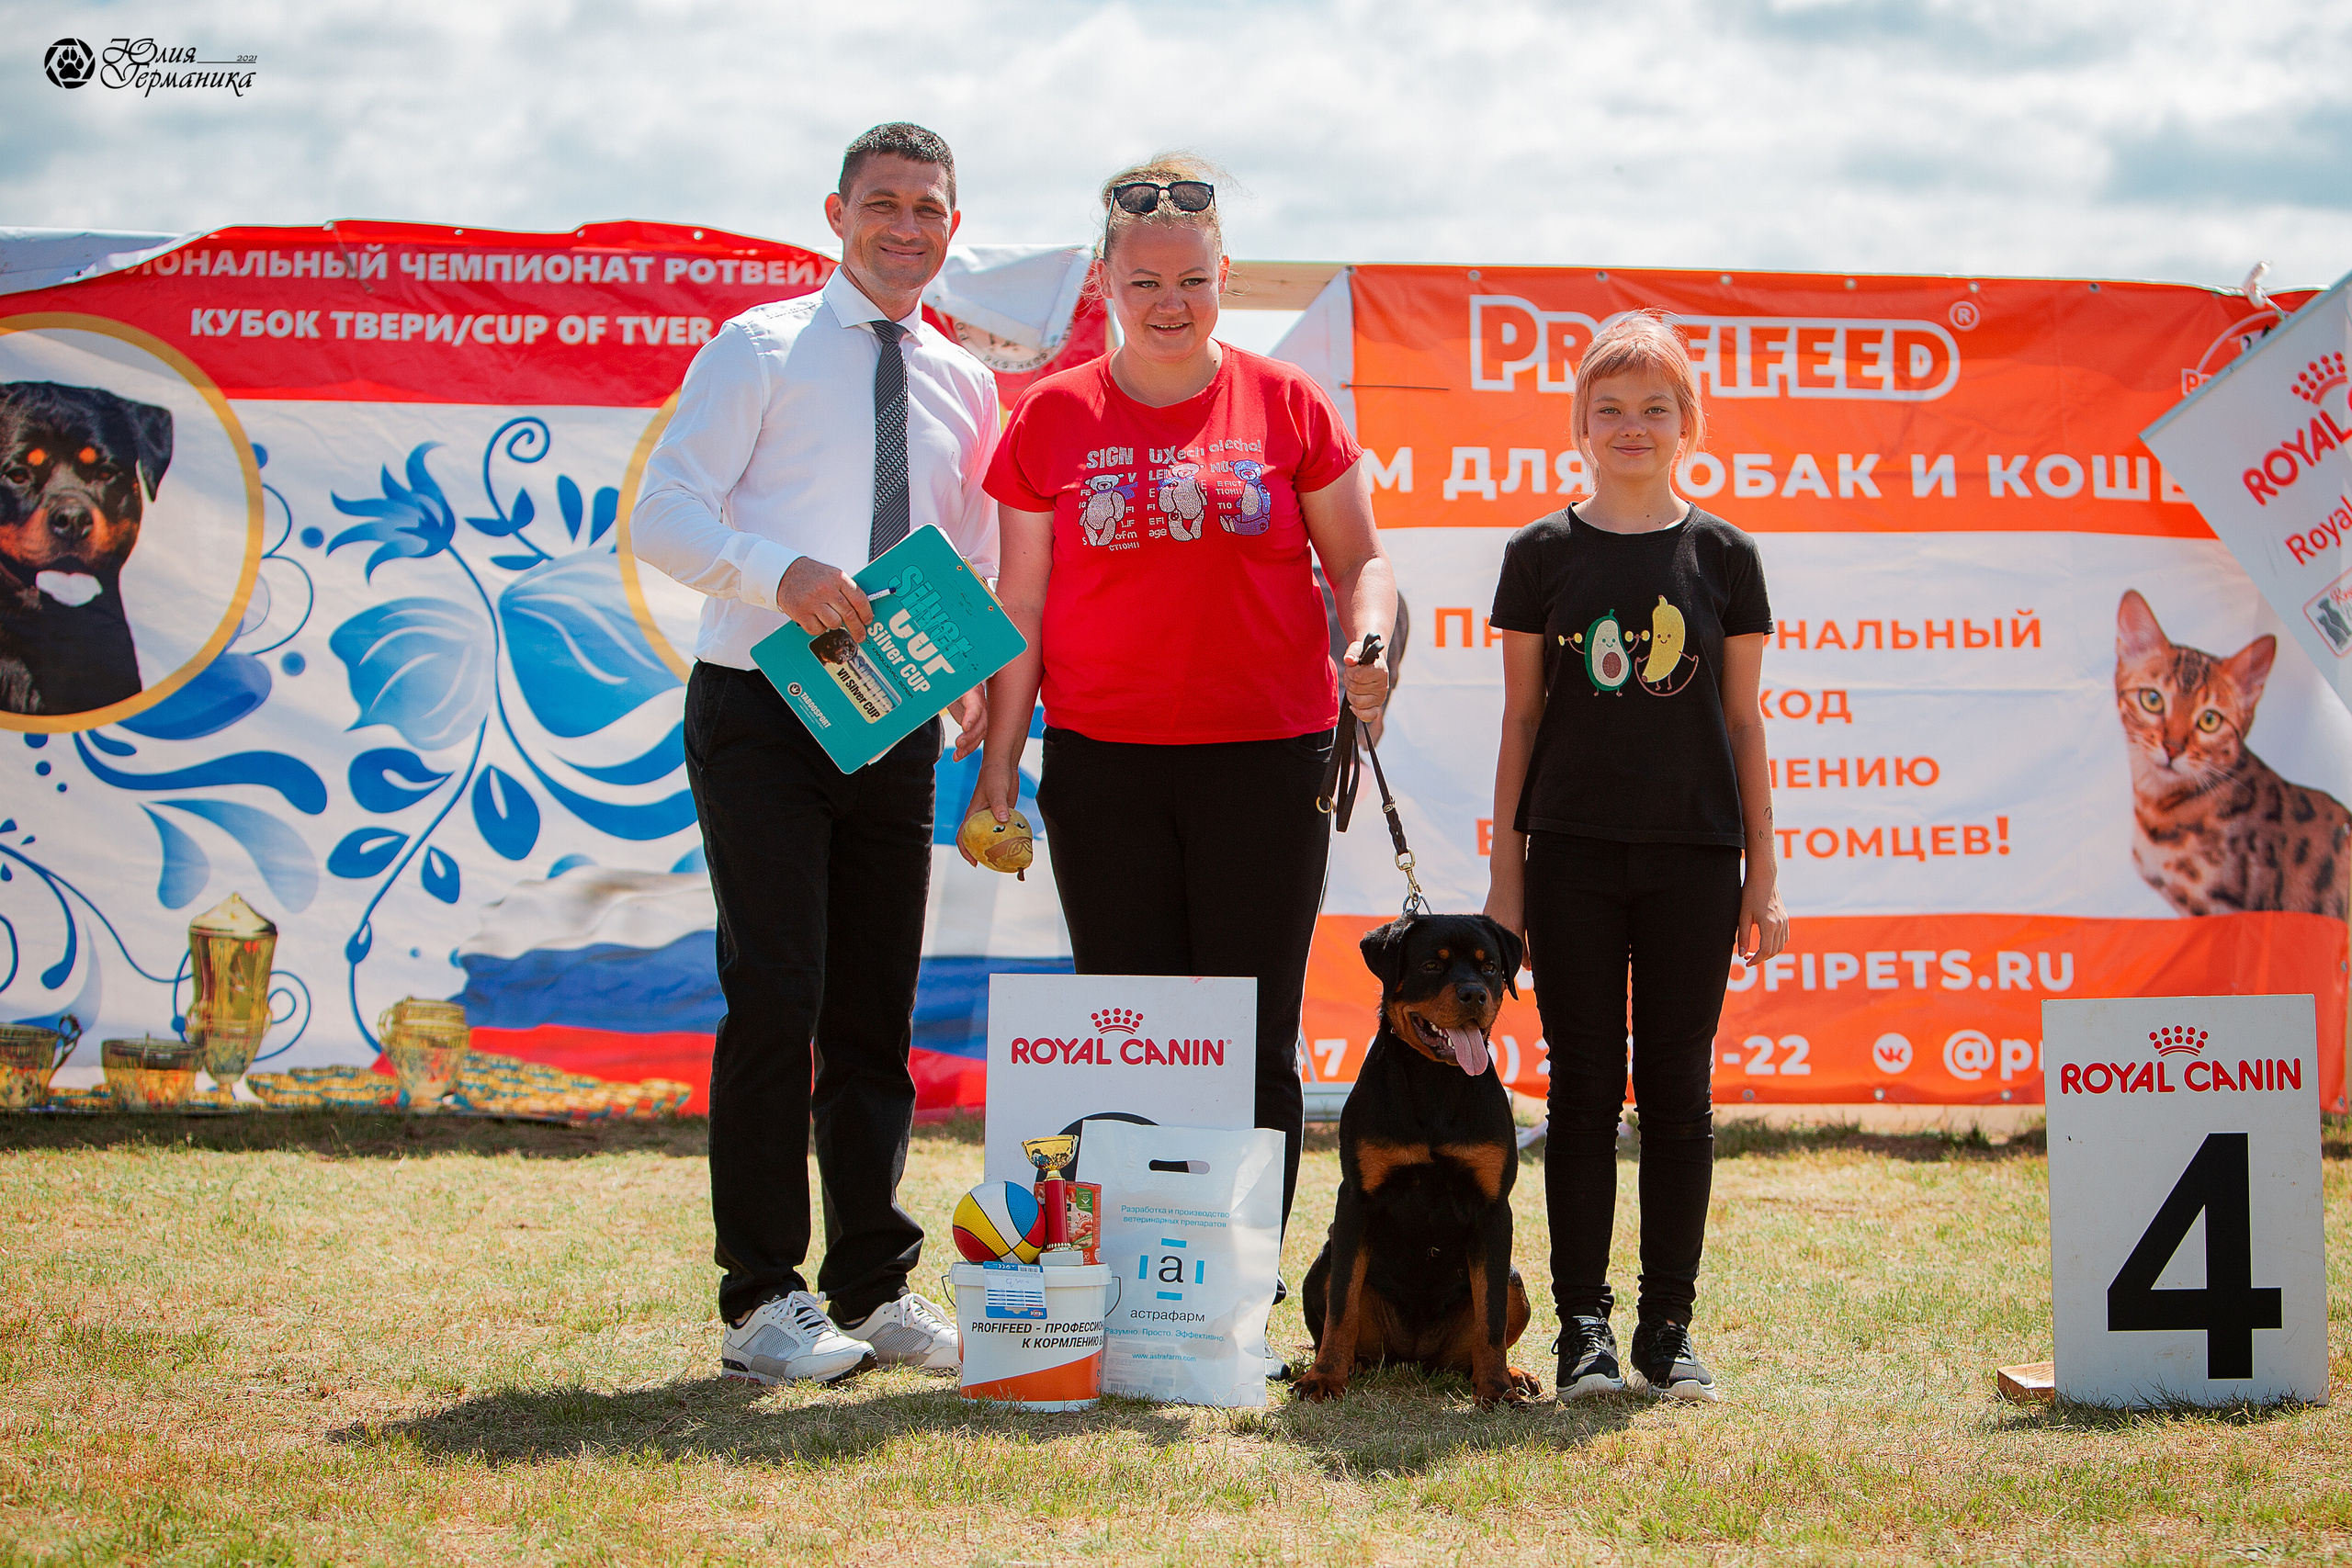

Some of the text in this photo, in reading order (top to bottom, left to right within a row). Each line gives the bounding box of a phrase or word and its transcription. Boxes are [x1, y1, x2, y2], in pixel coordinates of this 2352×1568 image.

[399, 252, 653, 284] ЧЕМПИОНАТ
[190, 308, 321, 339] КУБОК
[556, 315, 606, 344] OF
[616, 316, 713, 346] TVER
[1086, 446, 1134, 469] SIGN
[1443, 446, 1599, 501] ДЛЯ
[1675, 452, 1883, 499] ОБАК
[1911, 453, 1957, 498] И
[867, 621, 906, 665] Silver
[899, 662, 931, 693] CUP
[845, 678, 867, 704] Silver
[863, 700, 881, 718] CUP
[1770, 756, 1940, 789] ЕНИЮ
[1727, 951, 2075, 992] OFIPETS.RU
[1011, 1037, 1226, 1066] ROYAL CANIN
[2061, 1057, 2302, 1095] ROYAL CANIN
[1121, 1204, 1167, 1214] Разработка
[1174, 1208, 1230, 1219] производство
[1123, 1215, 1227, 1228] ветеринарных препаратов
[2107, 1132, 2283, 1381] 4
[971, 1321, 1033, 1334] PROFIFEED
[1130, 1309, 1205, 1323] астрафарм
[1022, 1337, 1032, 1348] К
[1034, 1336, 1099, 1348] КОРМЛЕНИЮ
[1104, 1326, 1226, 1342] Разумно. Просто. Эффективно.
[1132, 1353, 1197, 1362] www.astrafarm.com
